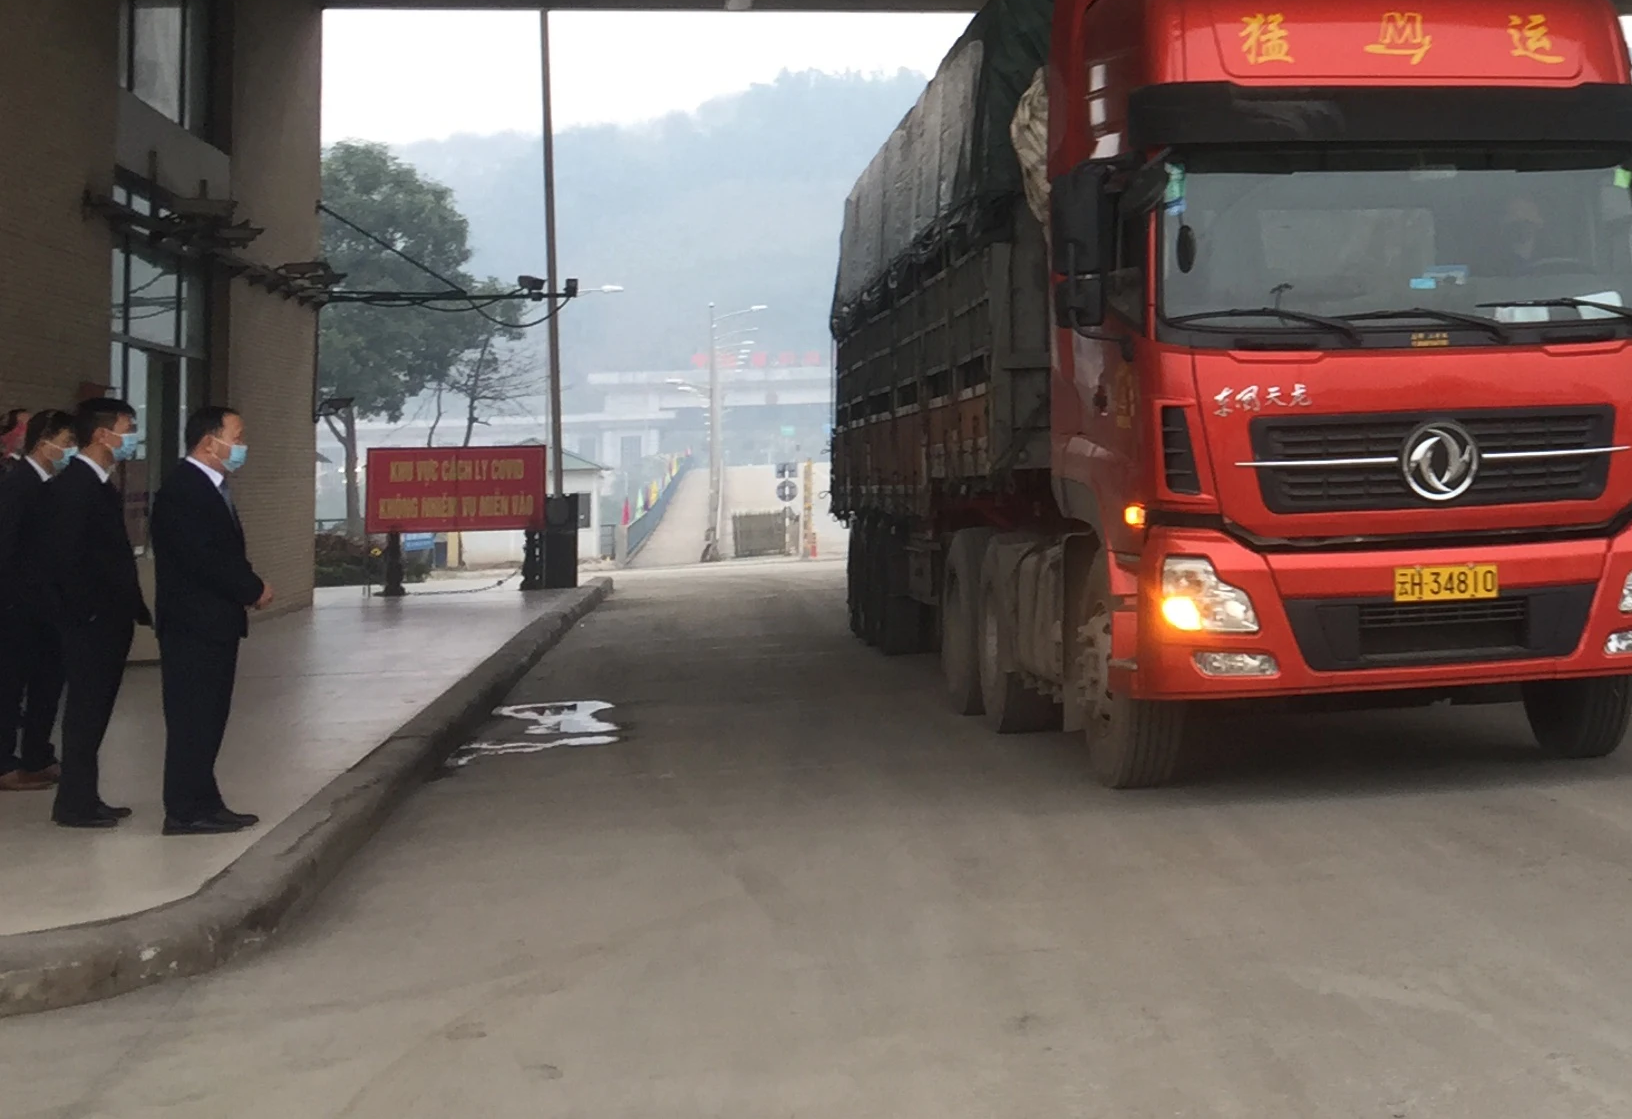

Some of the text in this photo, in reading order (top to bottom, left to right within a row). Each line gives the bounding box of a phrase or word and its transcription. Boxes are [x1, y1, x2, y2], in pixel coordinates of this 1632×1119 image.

[1238, 12, 1295, 65] 猛
[1507, 13, 1566, 64] 运
[475, 459, 489, 481] LY
